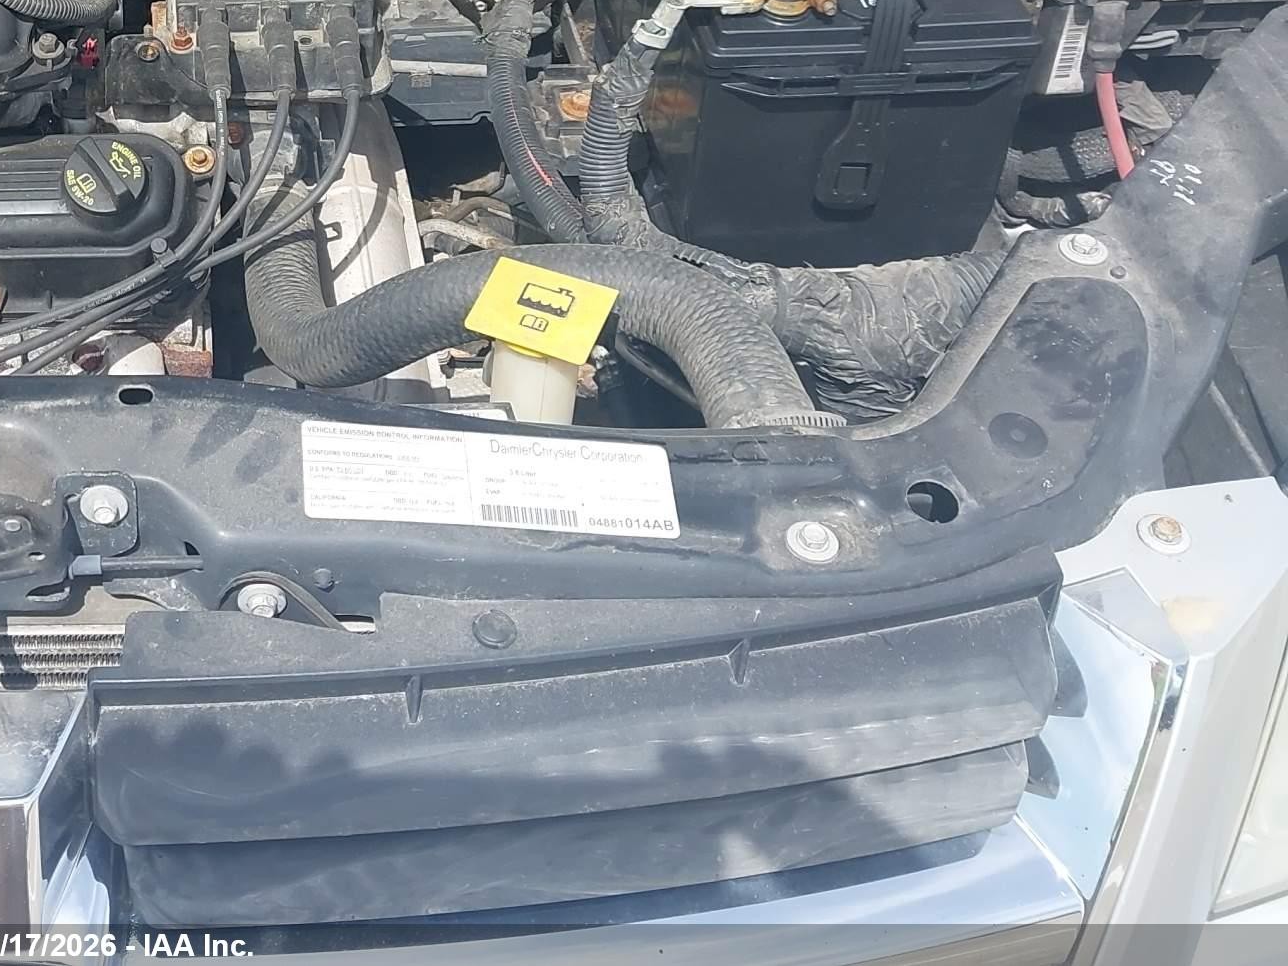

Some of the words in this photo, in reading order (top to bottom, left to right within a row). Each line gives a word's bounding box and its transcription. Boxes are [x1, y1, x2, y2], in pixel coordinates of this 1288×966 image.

[111, 141, 139, 166] ENGINE
[132, 165, 142, 181] OIL
[66, 169, 77, 186] SAE
[71, 185, 94, 206] 5W-20
[307, 425, 336, 434] VEHICLE
[339, 428, 374, 437] EMISSION
[376, 431, 409, 440] CONTROL
[412, 434, 463, 443] INFORMATION
[489, 439, 577, 461] DaimlerChrysler
[579, 445, 644, 464] Corporation
[588, 517, 674, 532] 04881014AB
